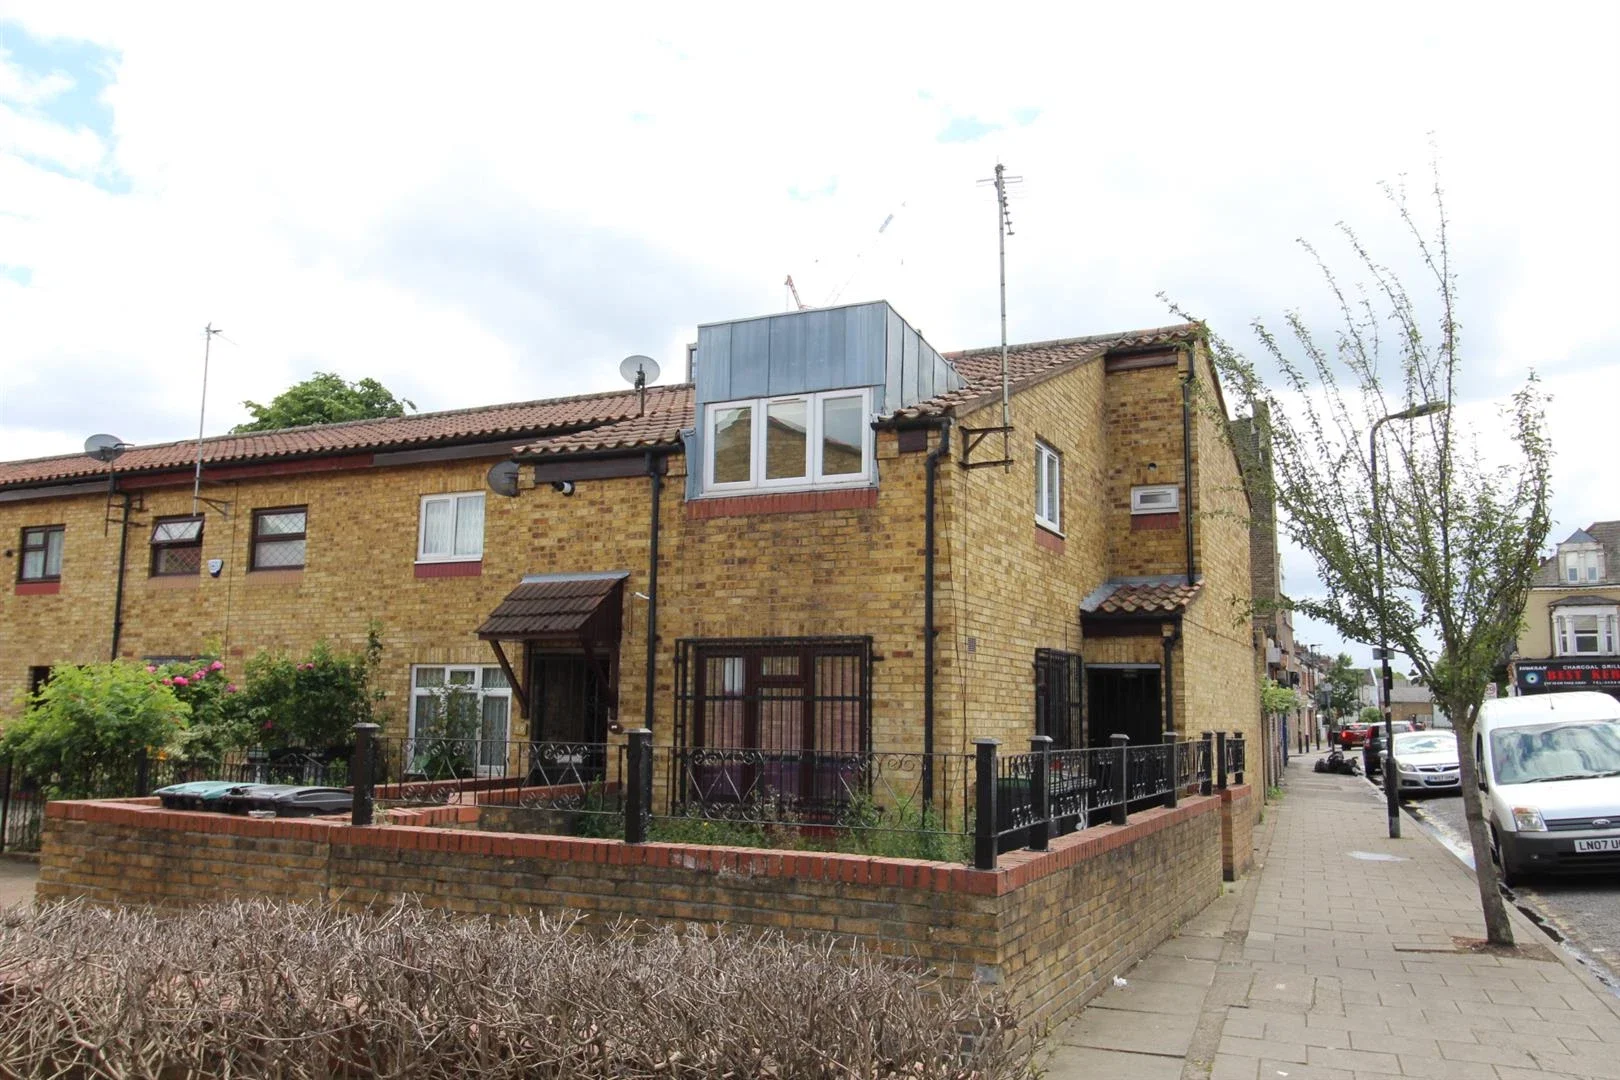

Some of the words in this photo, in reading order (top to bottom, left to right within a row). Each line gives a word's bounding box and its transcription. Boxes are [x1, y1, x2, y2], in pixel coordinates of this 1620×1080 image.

[1547, 671, 1582, 680] BEST
[1578, 840, 1608, 851] LN07
[1611, 839, 1620, 849] U
